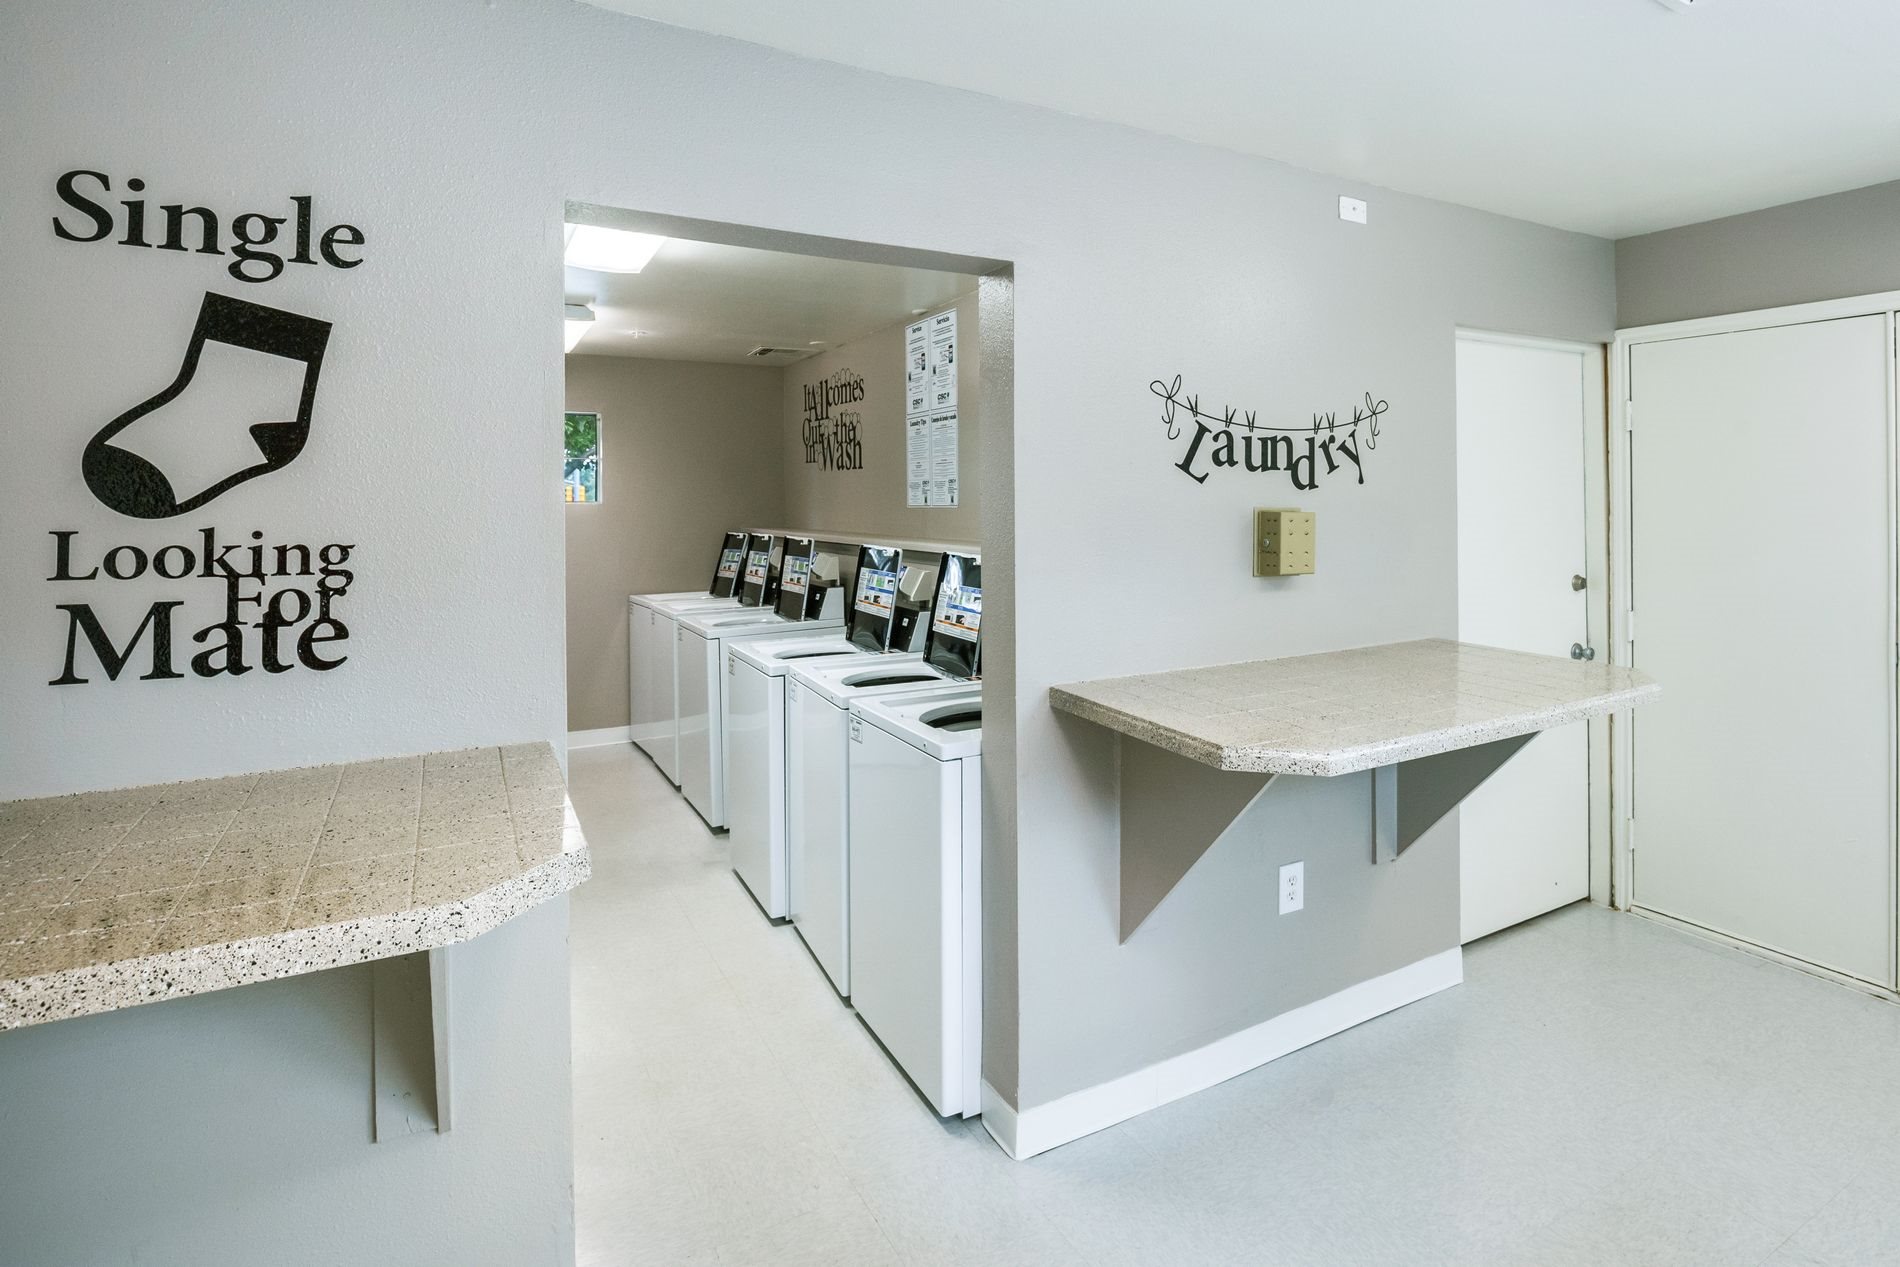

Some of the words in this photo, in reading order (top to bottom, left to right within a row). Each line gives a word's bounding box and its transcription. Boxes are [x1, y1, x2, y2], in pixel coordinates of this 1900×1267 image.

[52, 169, 366, 284] Single
[802, 417, 822, 446] Out
[835, 412, 856, 444] the
[803, 384, 811, 412] It
[809, 378, 830, 422] All
[820, 433, 864, 472] Wash
[1174, 419, 1364, 491] Laundry
[46, 526, 356, 592] Looking
[219, 571, 348, 628] For
[47, 600, 351, 687] Mate
